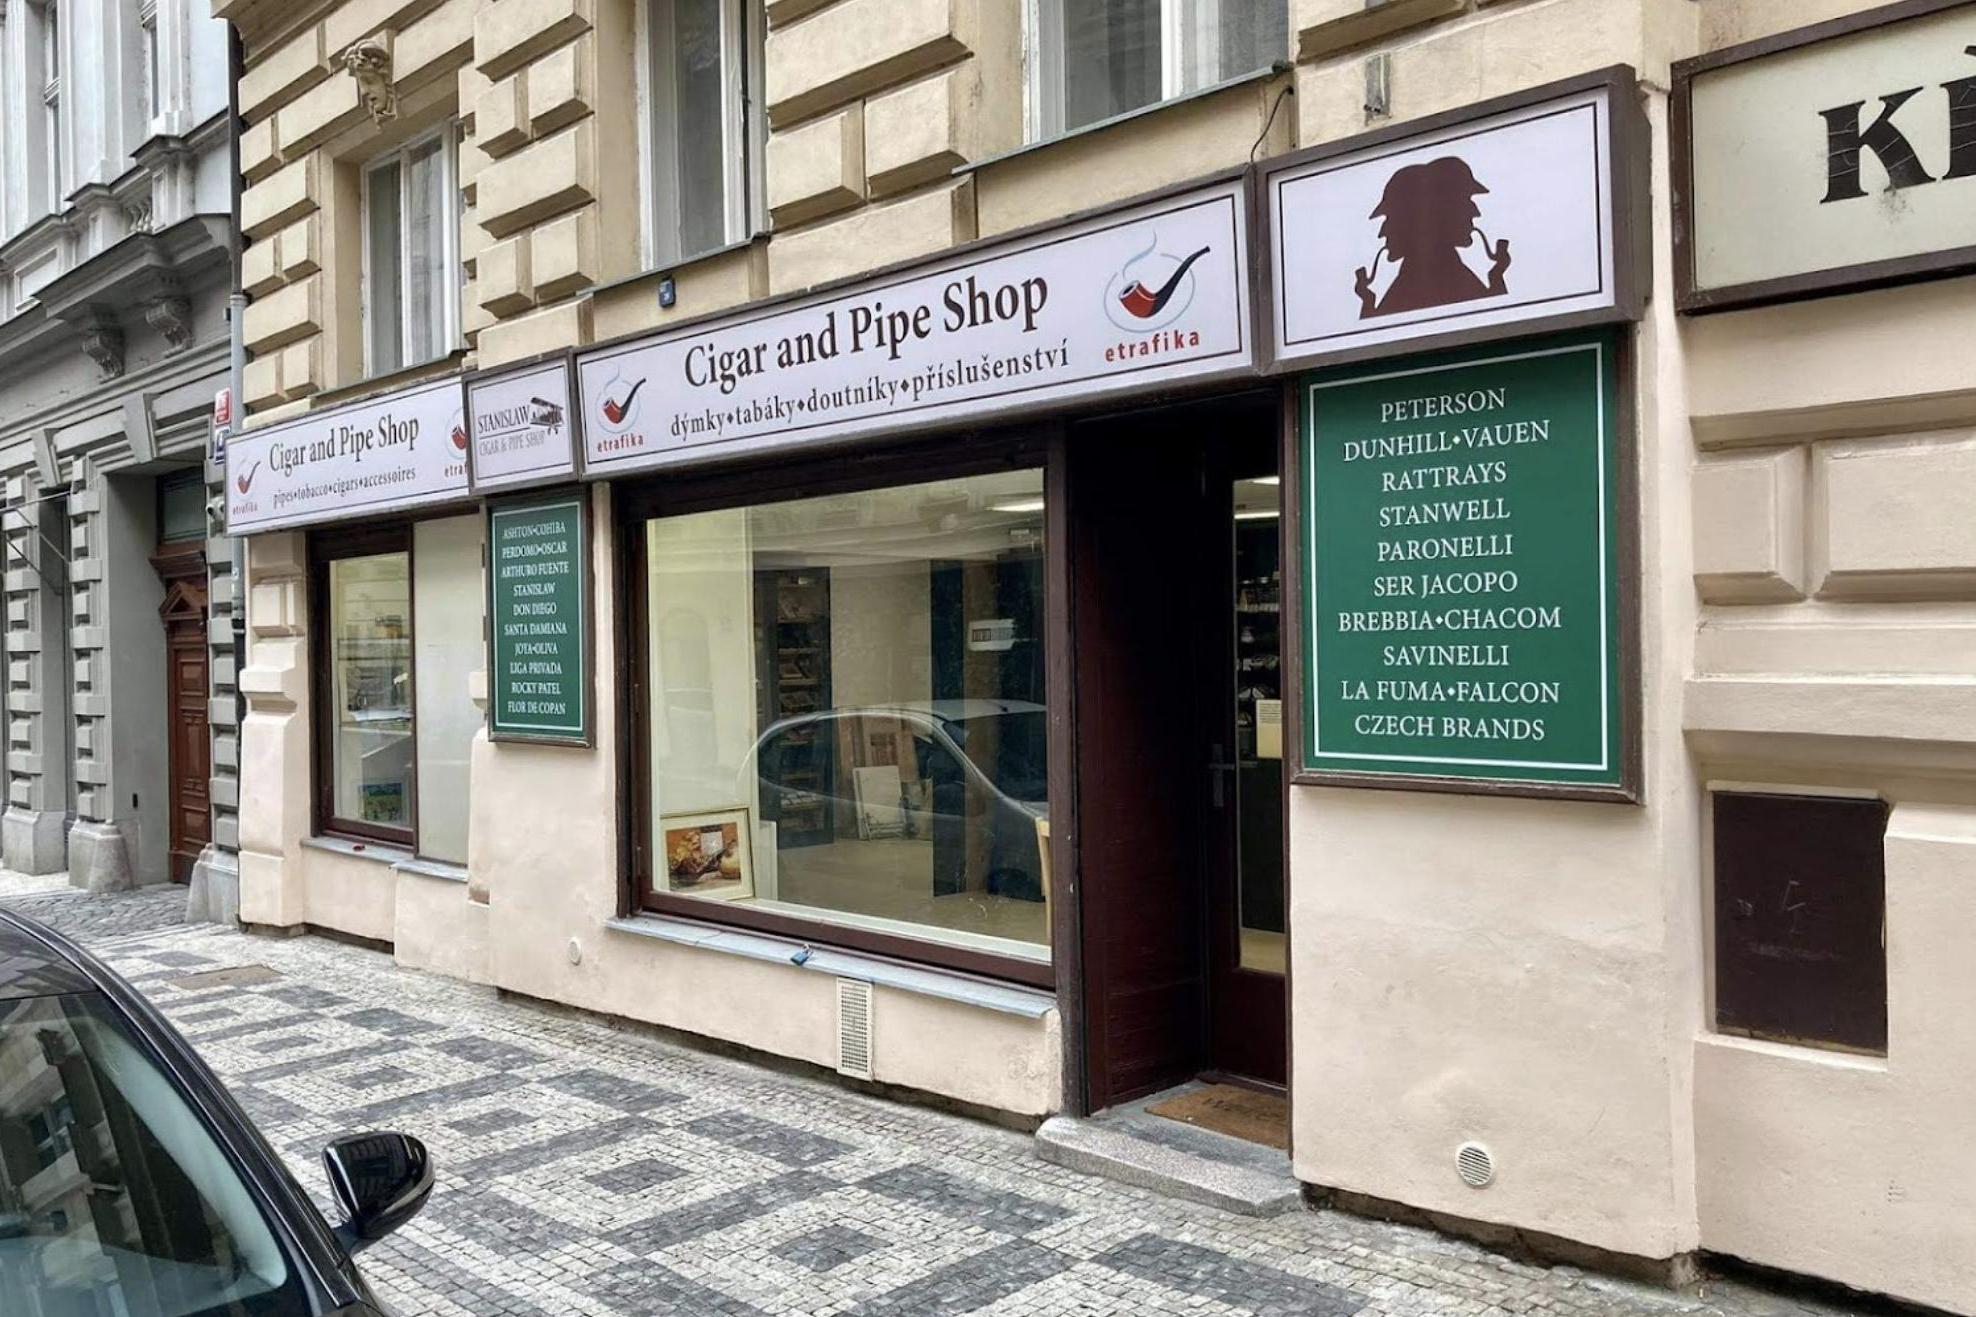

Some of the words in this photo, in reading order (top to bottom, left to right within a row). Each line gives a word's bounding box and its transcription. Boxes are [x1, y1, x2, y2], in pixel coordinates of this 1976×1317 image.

[685, 343, 768, 395] Cigar
[777, 311, 839, 369] and
[848, 302, 932, 361] Pipe
[943, 275, 1048, 333] Shop
[1105, 329, 1200, 362] etrafika
[671, 408, 726, 441] dýmky
[736, 395, 795, 424] tabáky
[807, 376, 898, 412] doutníky
[912, 338, 1069, 401] příslušenství
[1380, 388, 1506, 423] PETERSON
[478, 405, 530, 434] STANISLAW
[269, 442, 307, 478] Cigar
[309, 428, 336, 463] and
[340, 423, 373, 462] Pipe
[378, 414, 419, 451] Shop
[509, 436, 523, 451] PIPE
[525, 431, 545, 448] SHOP
[597, 434, 644, 452] etrafika
[1344, 431, 1453, 462] DUNHILL
[1461, 419, 1550, 449] VAUEN
[1381, 461, 1507, 493] RATTRAYS
[232, 501, 259, 516] etrafika
[1379, 498, 1511, 528] STANWELL
[540, 541, 568, 555] OSCAR
[1377, 534, 1513, 562] PARONELLI
[501, 564, 538, 578] ARTHURO
[539, 561, 569, 575] FUENTE
[513, 582, 556, 597] STANISLAW
[1374, 575, 1416, 598] SER
[1420, 571, 1519, 599] JACOPO
[513, 603, 531, 616] DON
[532, 602, 557, 615] DIEGO
[1339, 610, 1435, 633] BREBBIA
[1444, 607, 1562, 631] CHACOM
[504, 623, 529, 636] SANTA
[530, 622, 568, 635] DAMIANA
[510, 662, 528, 674] LIGA
[529, 662, 562, 674] PRIVADA
[1383, 645, 1510, 666] SAVINELLI
[512, 681, 537, 694] ROCKY
[538, 682, 562, 695] PATEL
[1341, 680, 1370, 701] LA
[1377, 681, 1447, 702] FUMA
[1455, 682, 1561, 704] FALCON
[508, 701, 527, 713] FLOR
[527, 701, 538, 714] DE
[538, 702, 566, 715] COPAN
[1355, 715, 1435, 737] CZECH
[1442, 718, 1545, 741] BRANDS
